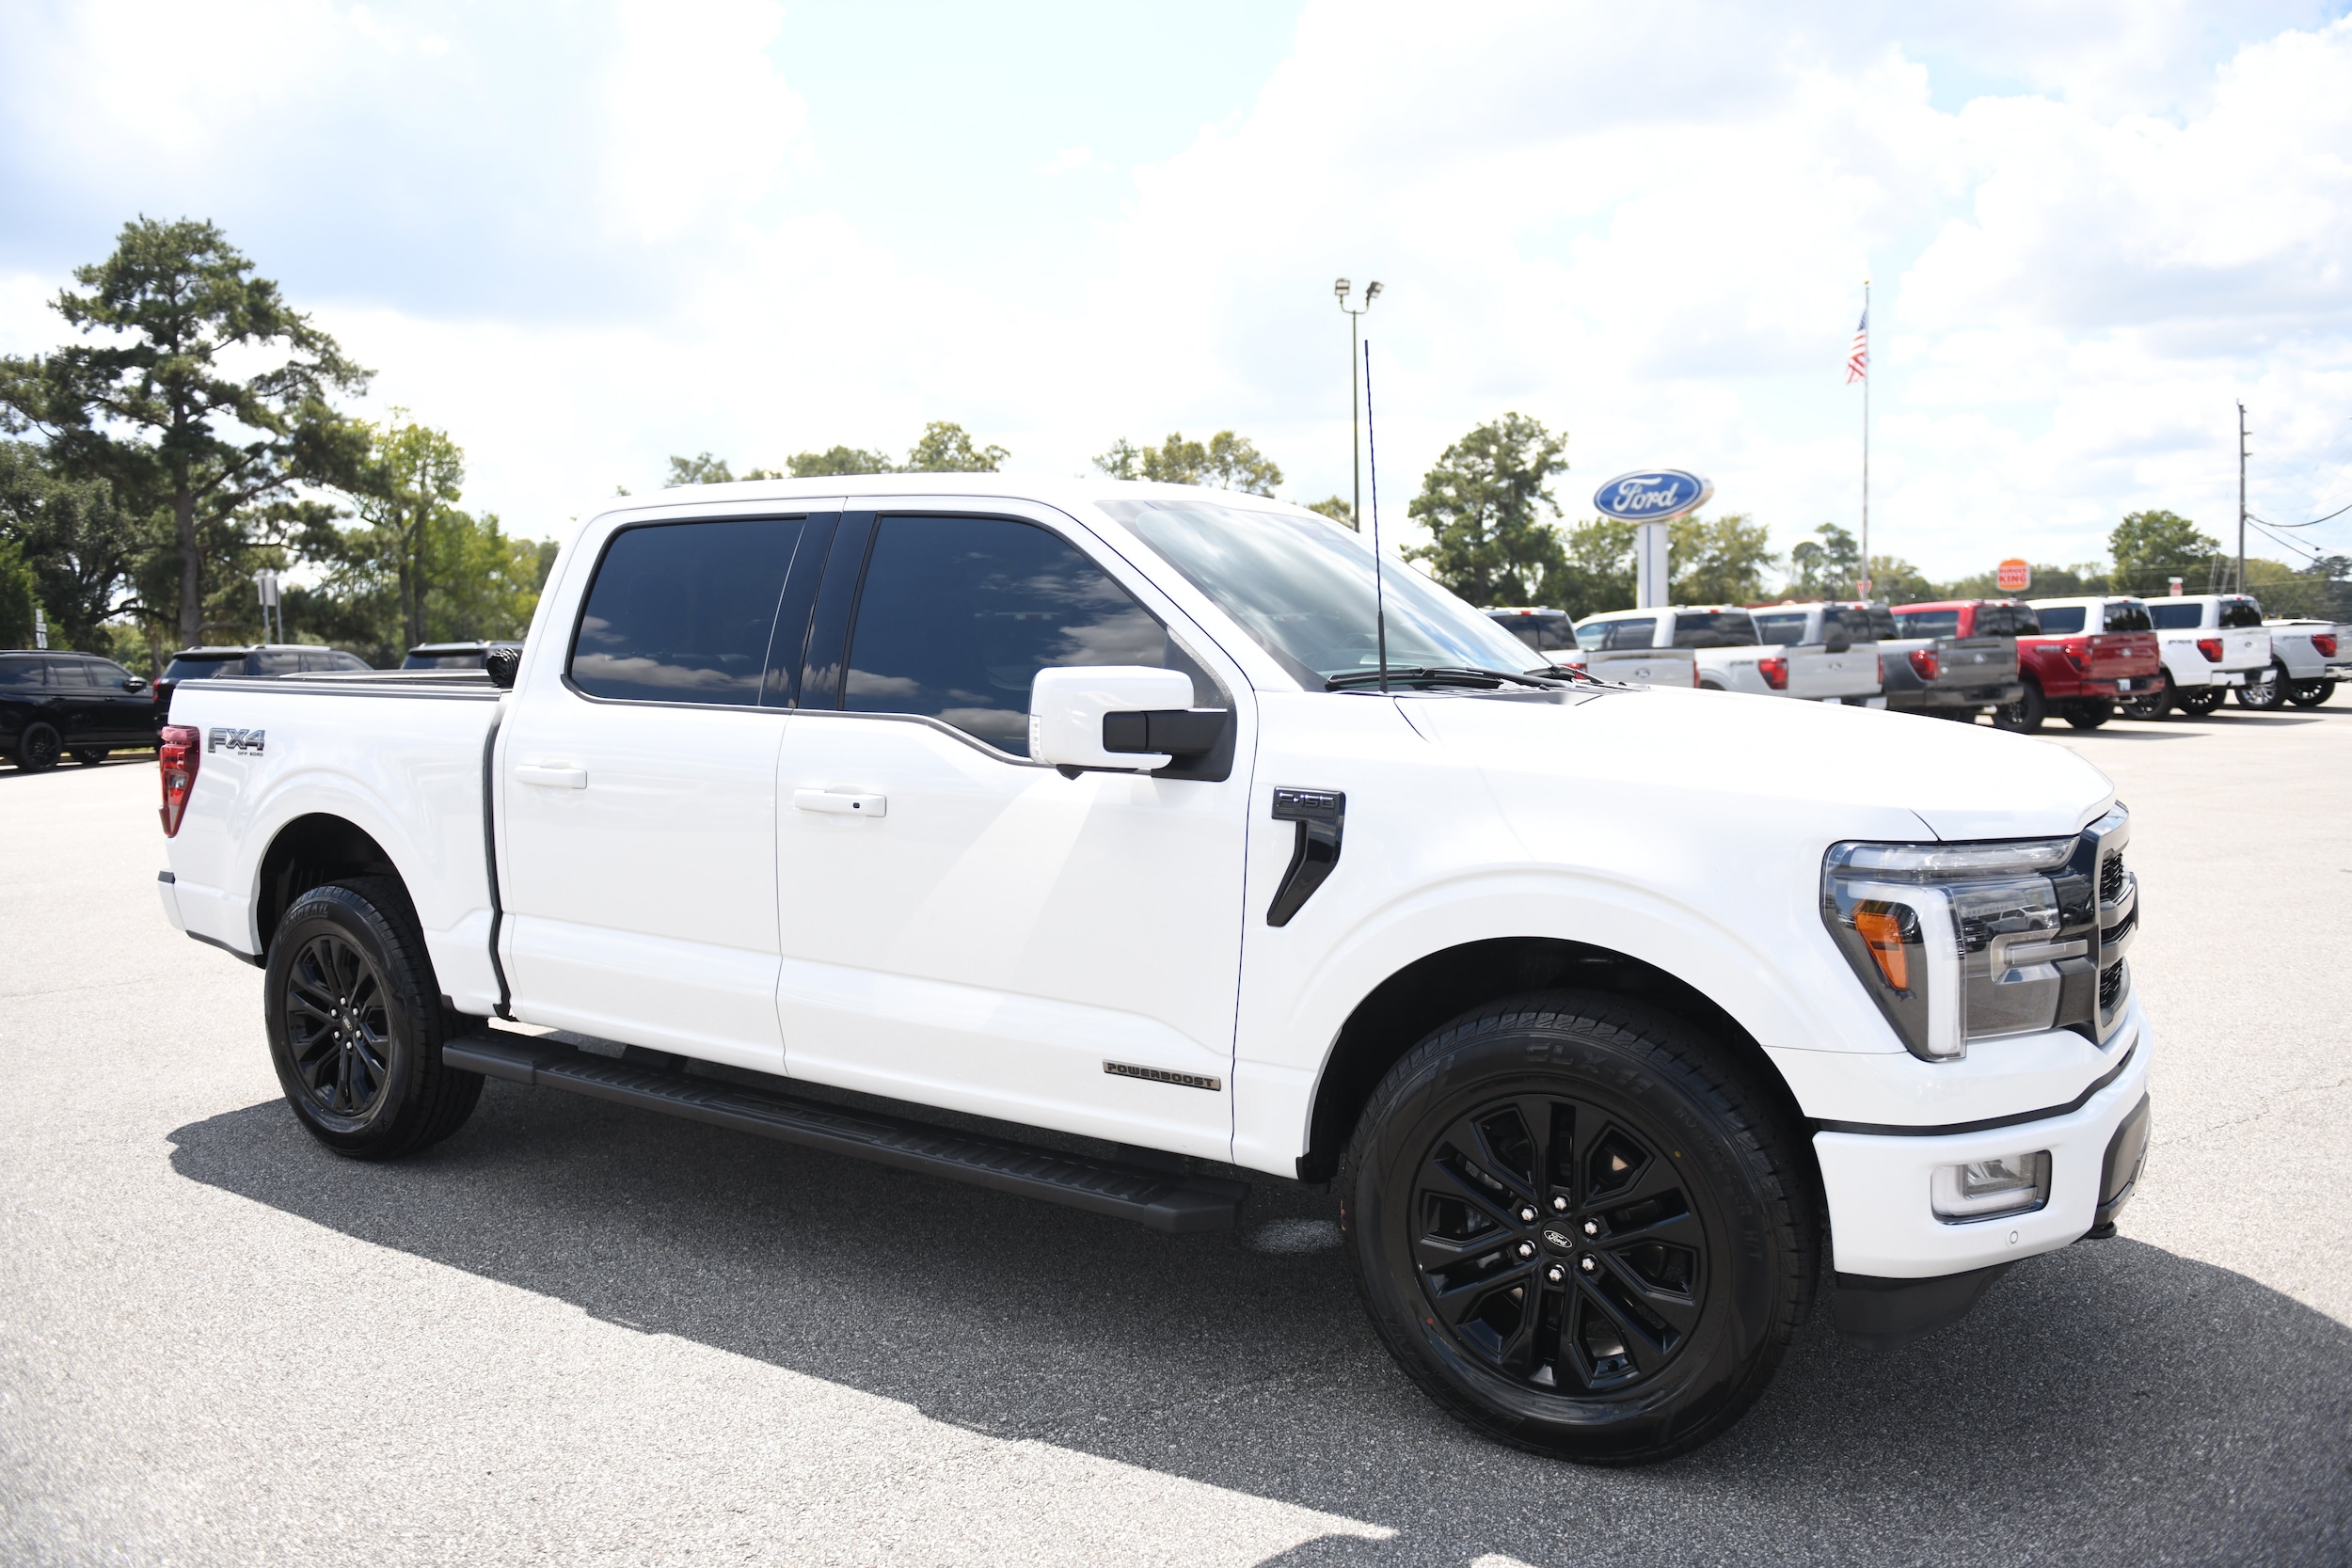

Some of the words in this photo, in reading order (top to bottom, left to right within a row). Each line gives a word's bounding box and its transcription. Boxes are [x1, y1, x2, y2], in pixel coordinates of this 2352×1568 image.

[1613, 477, 1679, 512] Ford
[208, 727, 265, 752] FX4
[1279, 792, 1335, 808] F-150
[1106, 1062, 1214, 1087] POWERBOOST
[1524, 1042, 1657, 1095] CLX-11
[1548, 1232, 1568, 1246] Ford
